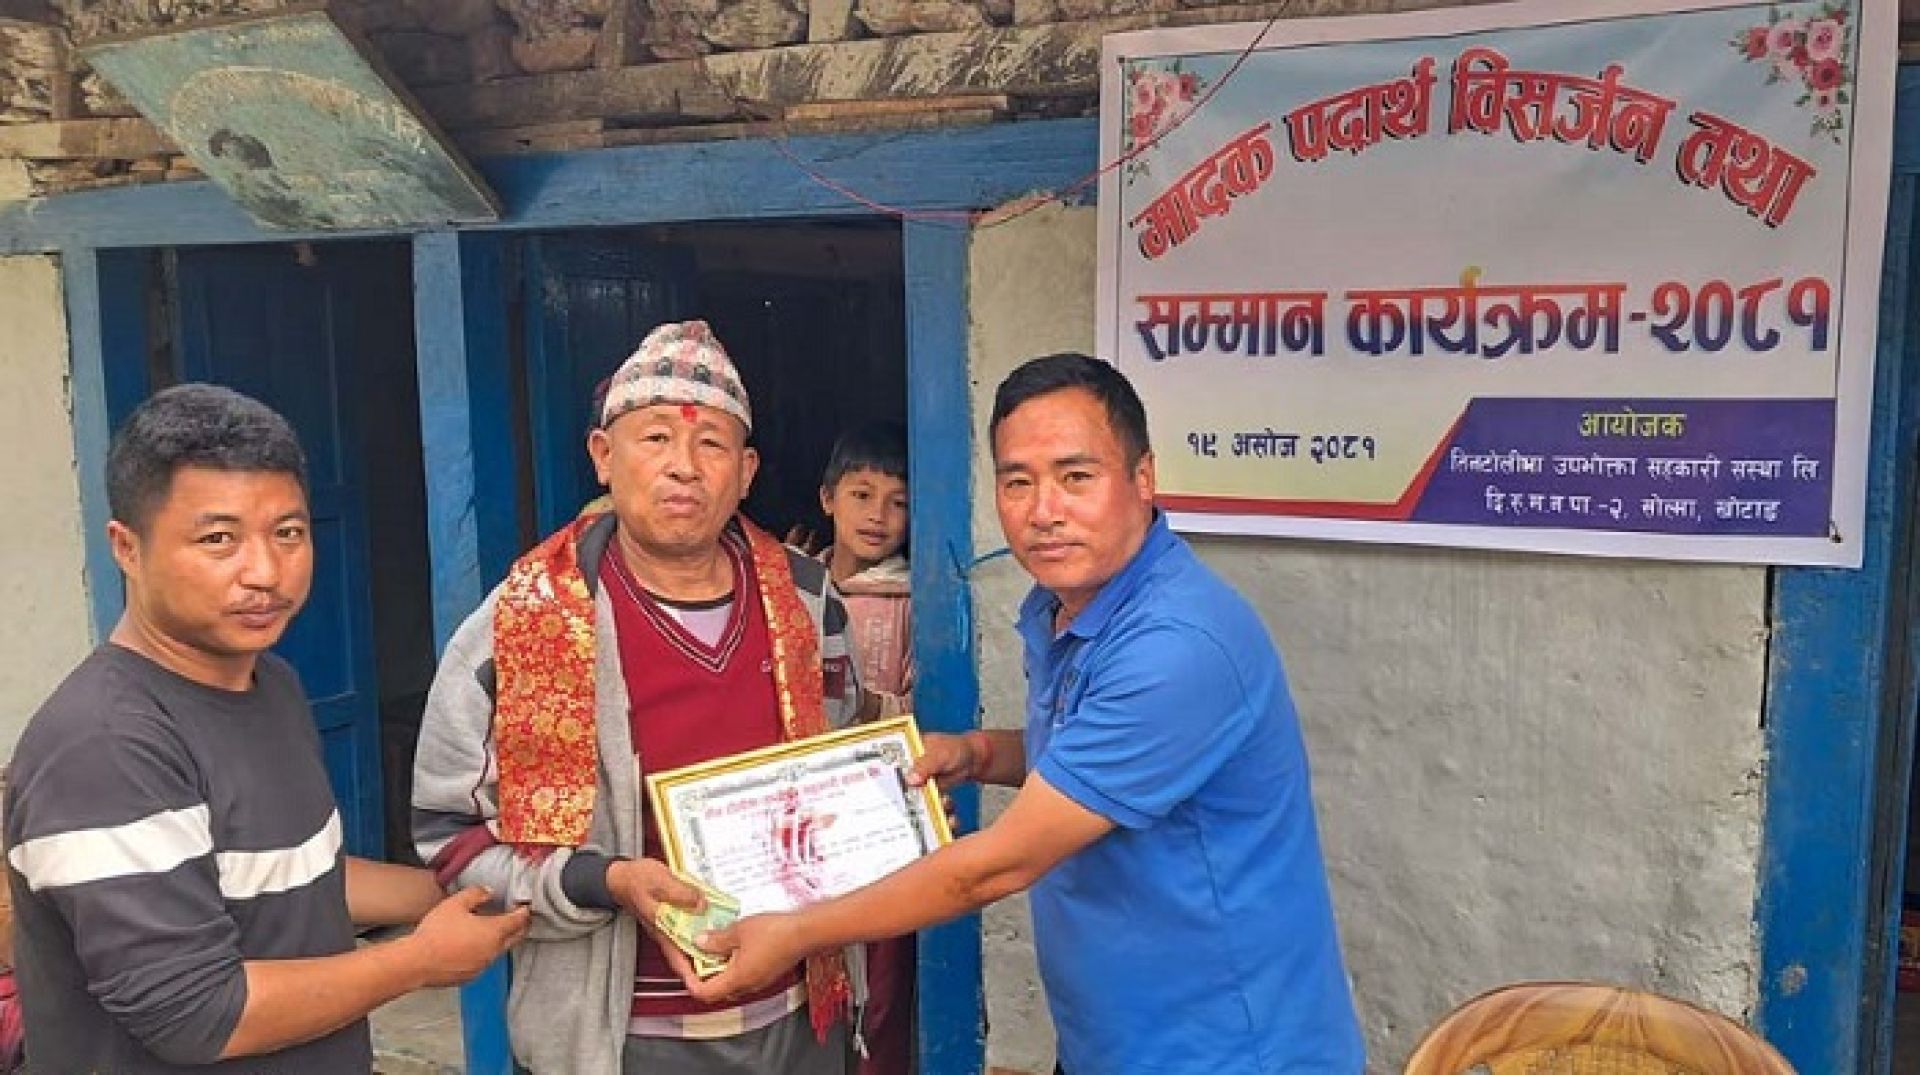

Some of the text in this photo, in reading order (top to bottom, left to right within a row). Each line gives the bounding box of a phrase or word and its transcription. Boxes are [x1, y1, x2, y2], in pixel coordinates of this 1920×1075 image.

[1129, 45, 1816, 260] मादक पदार्थ विसर्जन तथा
[1135, 291, 1328, 361] सम्मान
[1578, 406, 1688, 438] आयोजक
[1187, 427, 1375, 464] १९ असोज २०८१
[1646, 451, 1723, 484] सहकारी
